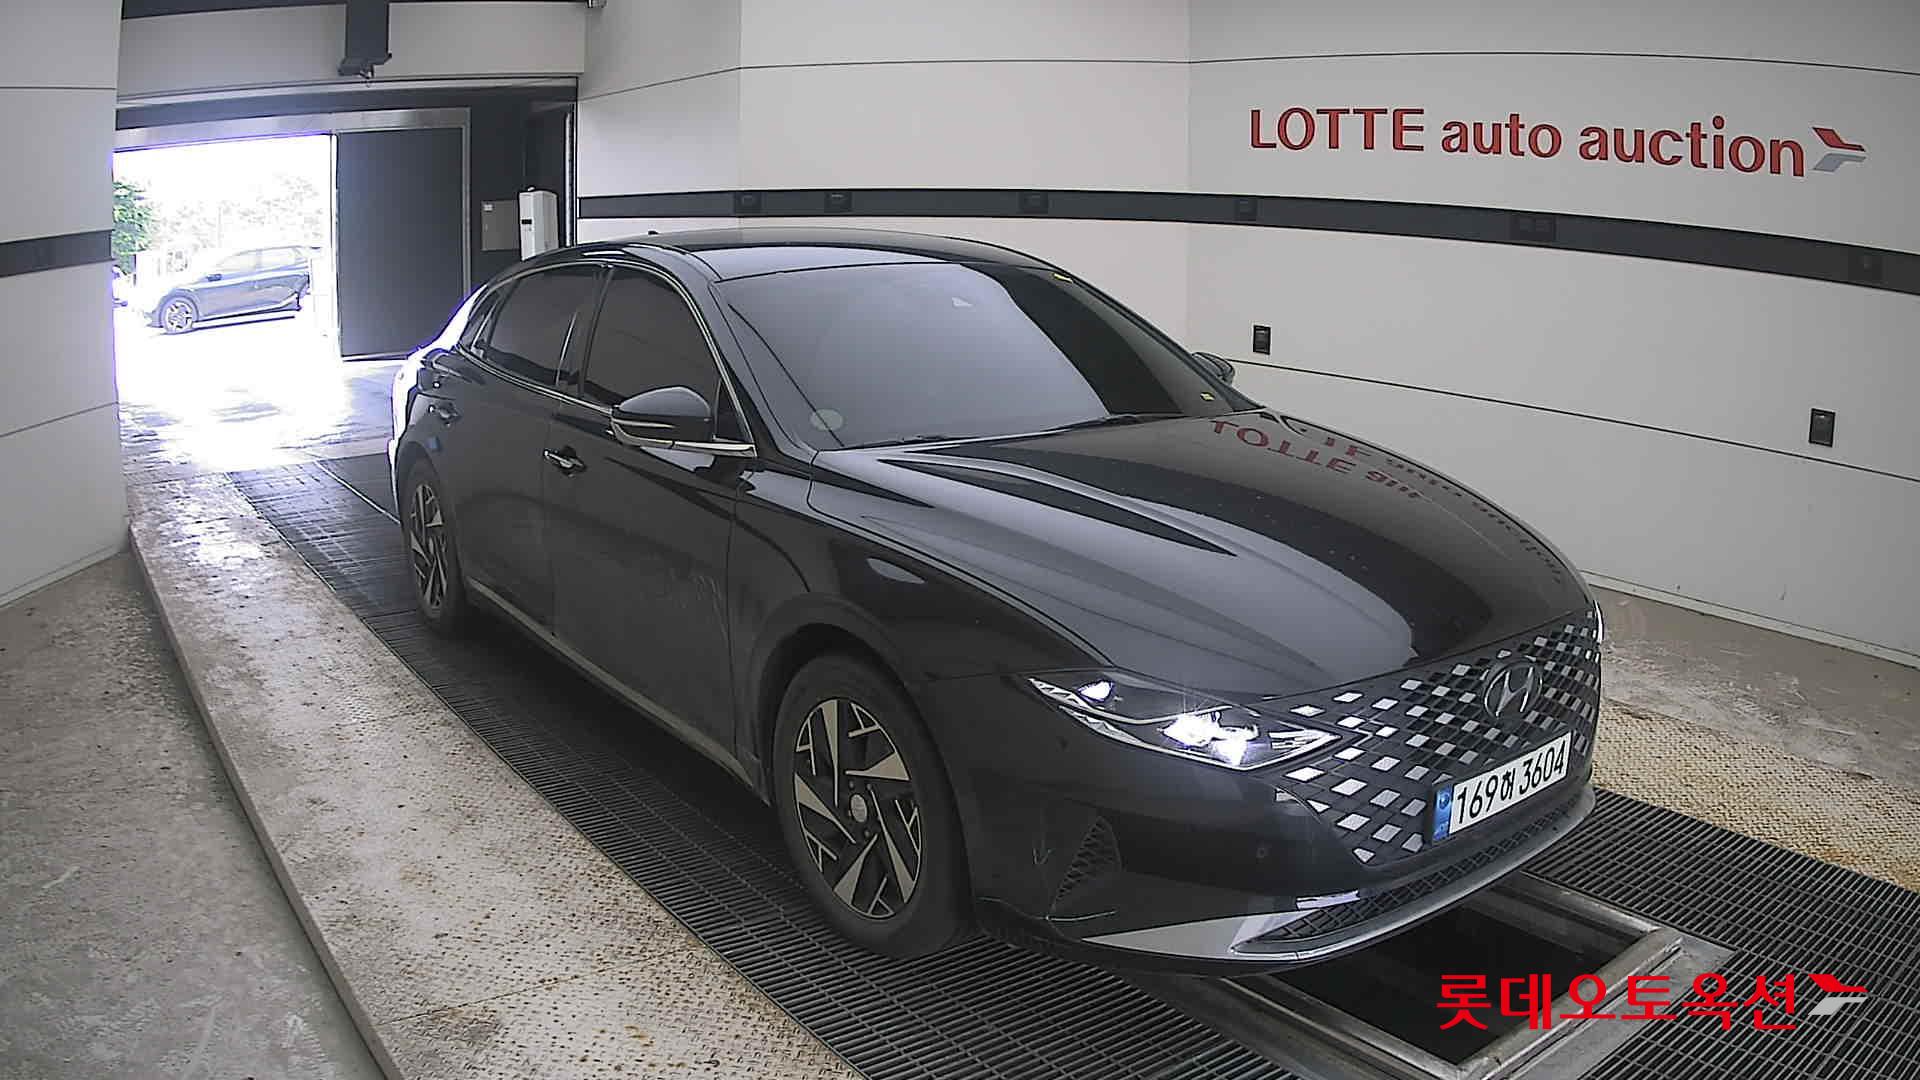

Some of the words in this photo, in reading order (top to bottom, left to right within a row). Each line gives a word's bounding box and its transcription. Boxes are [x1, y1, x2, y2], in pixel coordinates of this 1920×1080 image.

[1250, 107, 1425, 151] LOTTE
[1441, 113, 1563, 158] auto
[1578, 115, 1806, 177] auction
[1456, 767, 1517, 825] 169허
[1518, 739, 1568, 796] 3604
